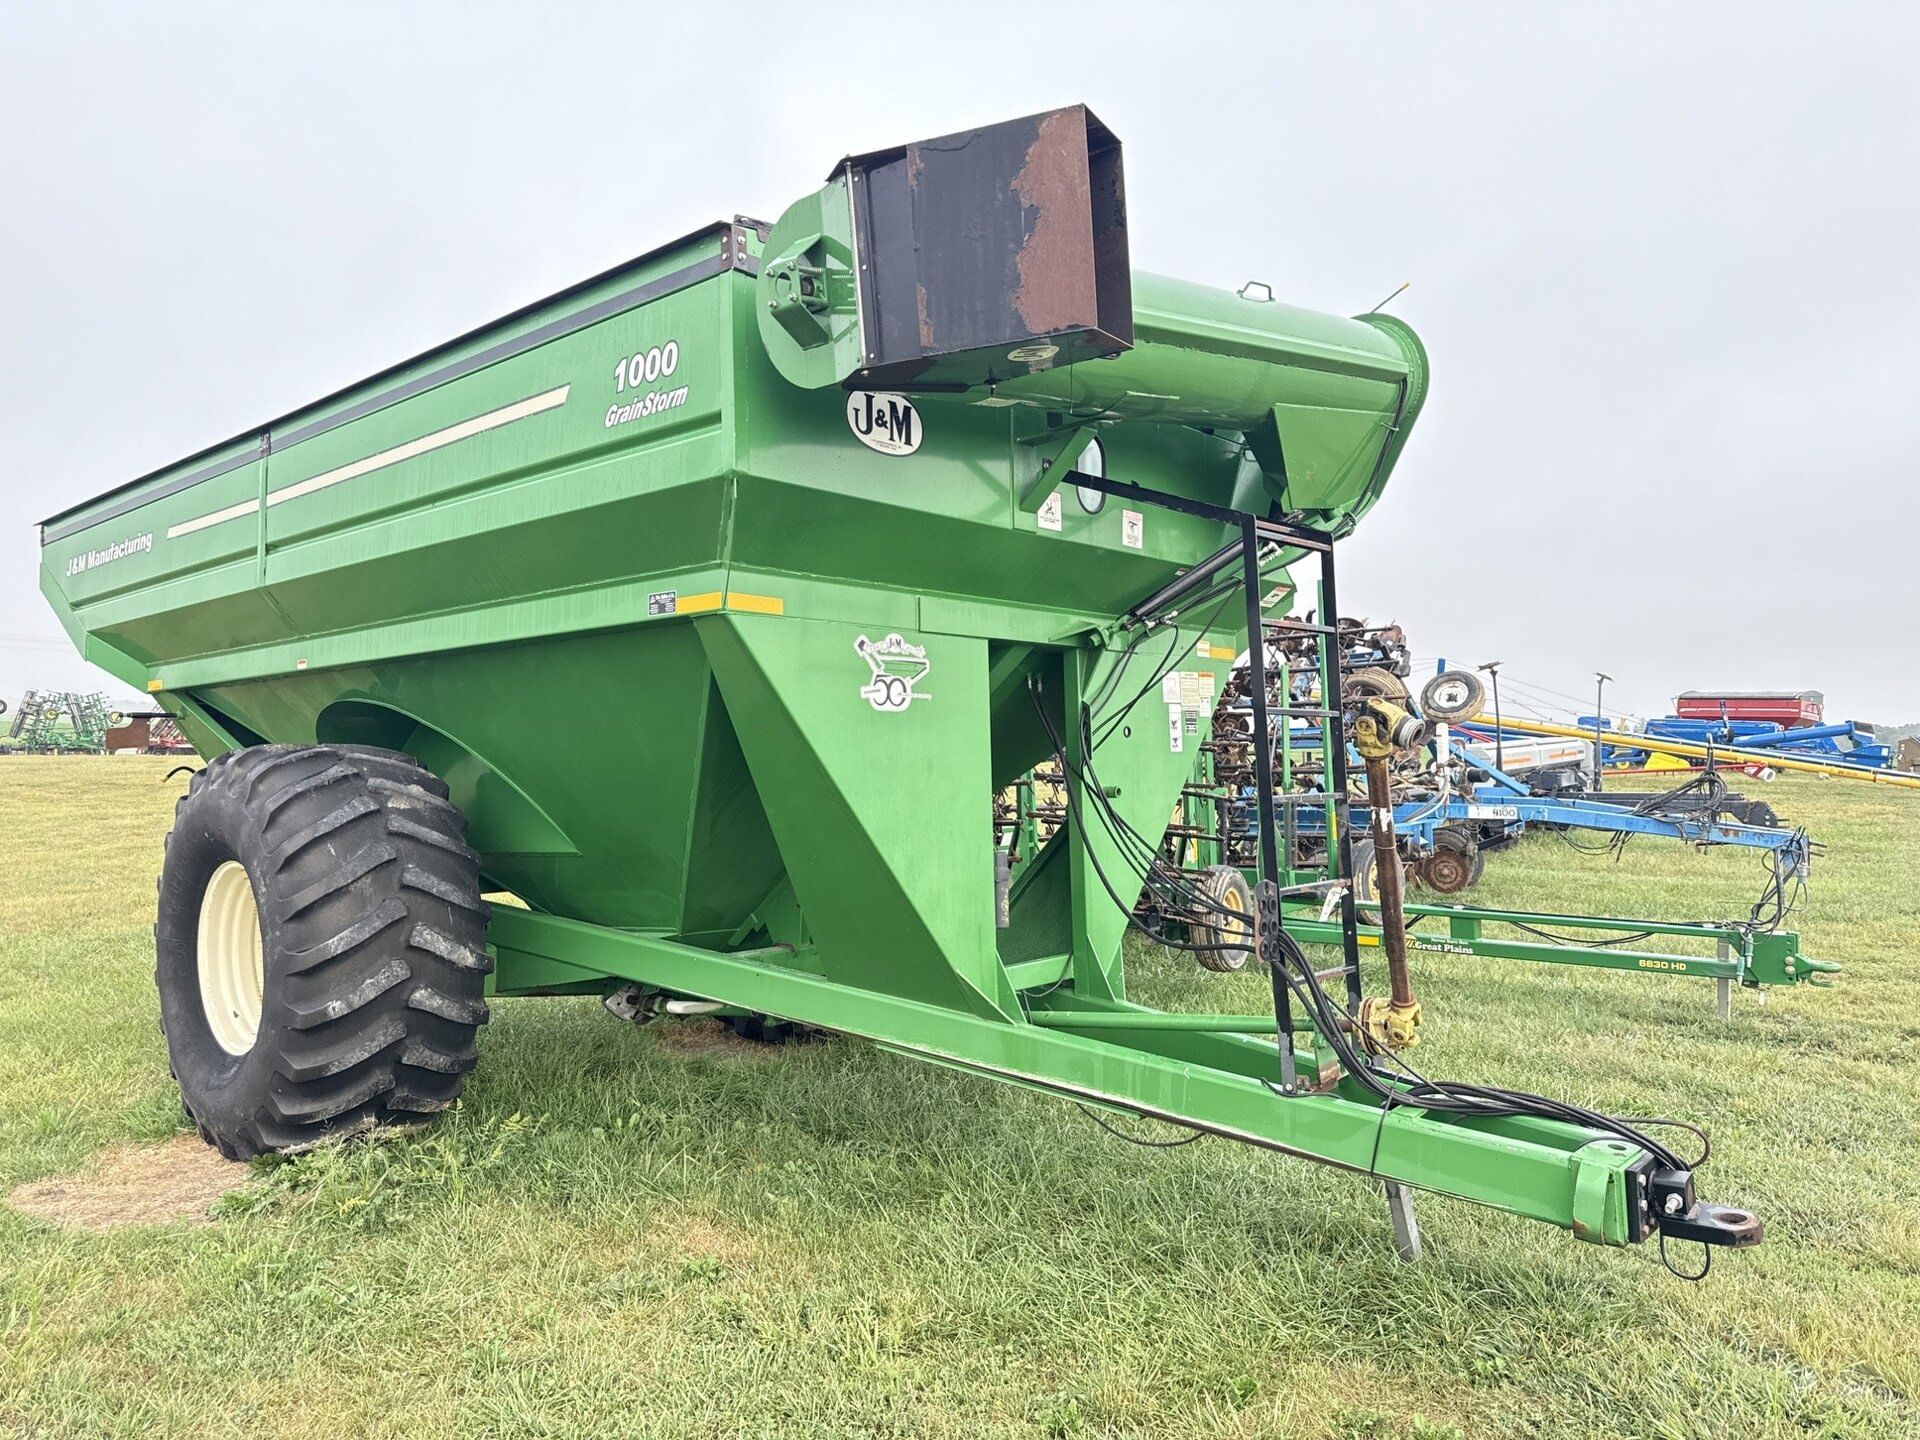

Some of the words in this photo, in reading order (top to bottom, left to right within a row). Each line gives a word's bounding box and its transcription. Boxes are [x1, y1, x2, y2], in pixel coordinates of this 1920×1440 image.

[613, 339, 680, 394] 1000
[604, 384, 689, 429] GrainStorm
[852, 392, 914, 447] J&M
[66, 554, 86, 577] J&M
[87, 532, 153, 569] Manufacturing
[873, 674, 907, 707] 50
[1492, 808, 1516, 817] 4100
[1414, 940, 1442, 951] Great
[1443, 943, 1474, 954] Plains
[1671, 962, 1687, 971] HD
